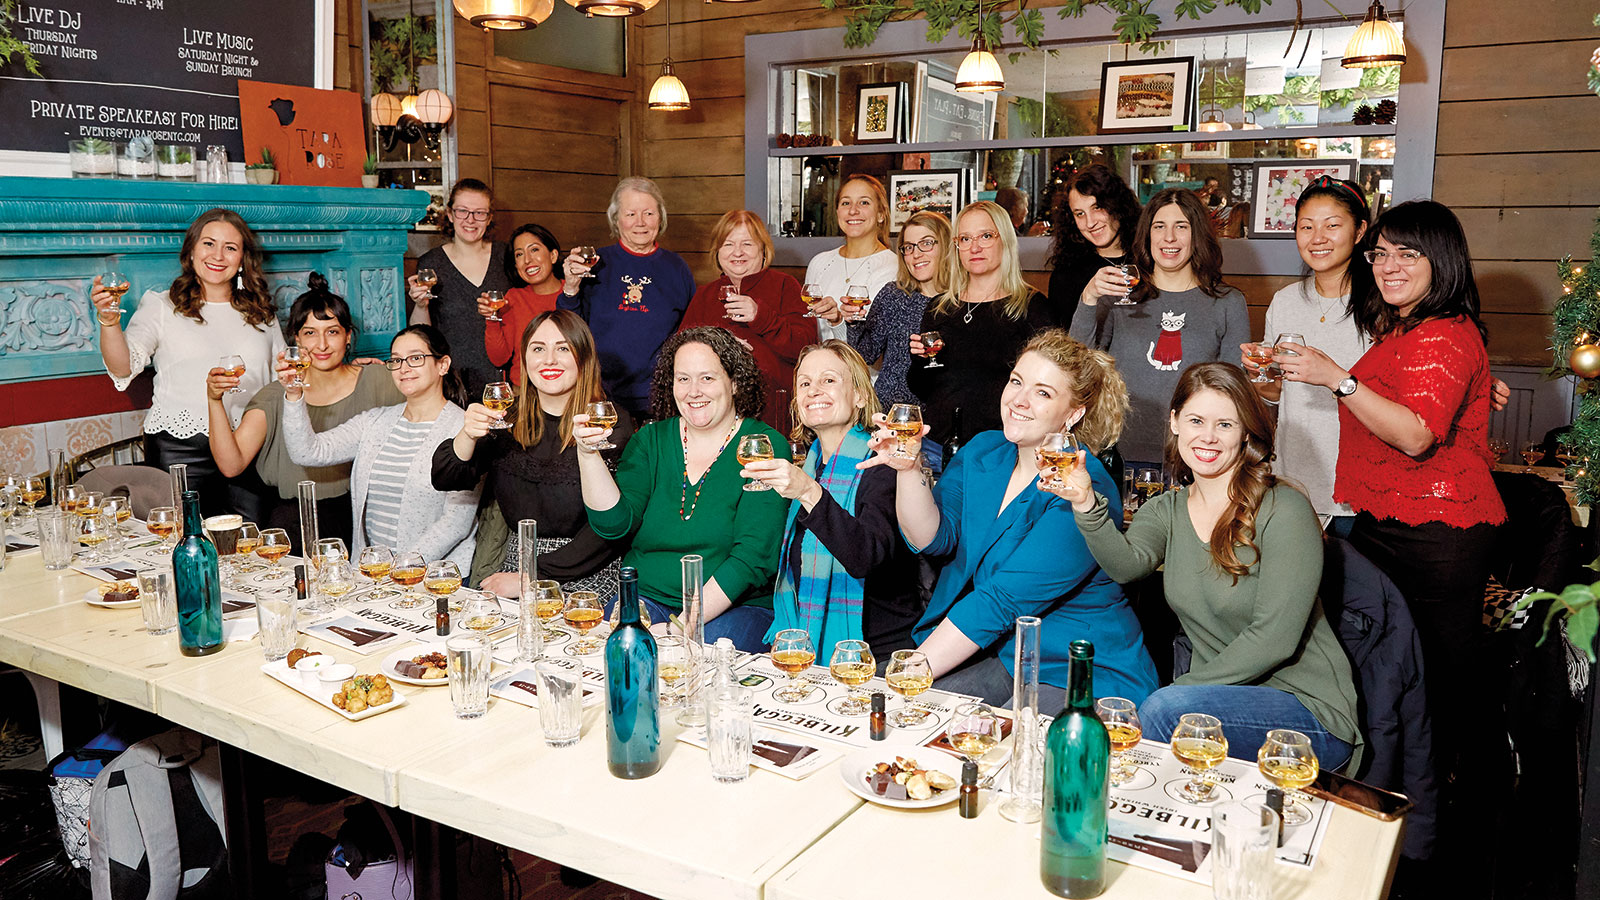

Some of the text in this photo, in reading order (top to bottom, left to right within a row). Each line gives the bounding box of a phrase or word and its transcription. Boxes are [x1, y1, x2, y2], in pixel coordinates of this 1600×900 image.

[17, 4, 82, 30] LIVE DJ
[25, 27, 78, 45] THURSDAY
[183, 27, 254, 51] LIVE MUSIC
[61, 46, 98, 60] NIGHTS
[178, 47, 222, 62] SATURDAY
[224, 52, 249, 65] NIGHT
[185, 60, 252, 78] SUNDAY BRUNCH
[30, 99, 239, 130] PRIVATE SPEAKEASY FOR HIRE!
[79, 125, 201, 143] EVENTS@TARAROSENYC.COM
[1108, 799, 1212, 833] KILBEG
